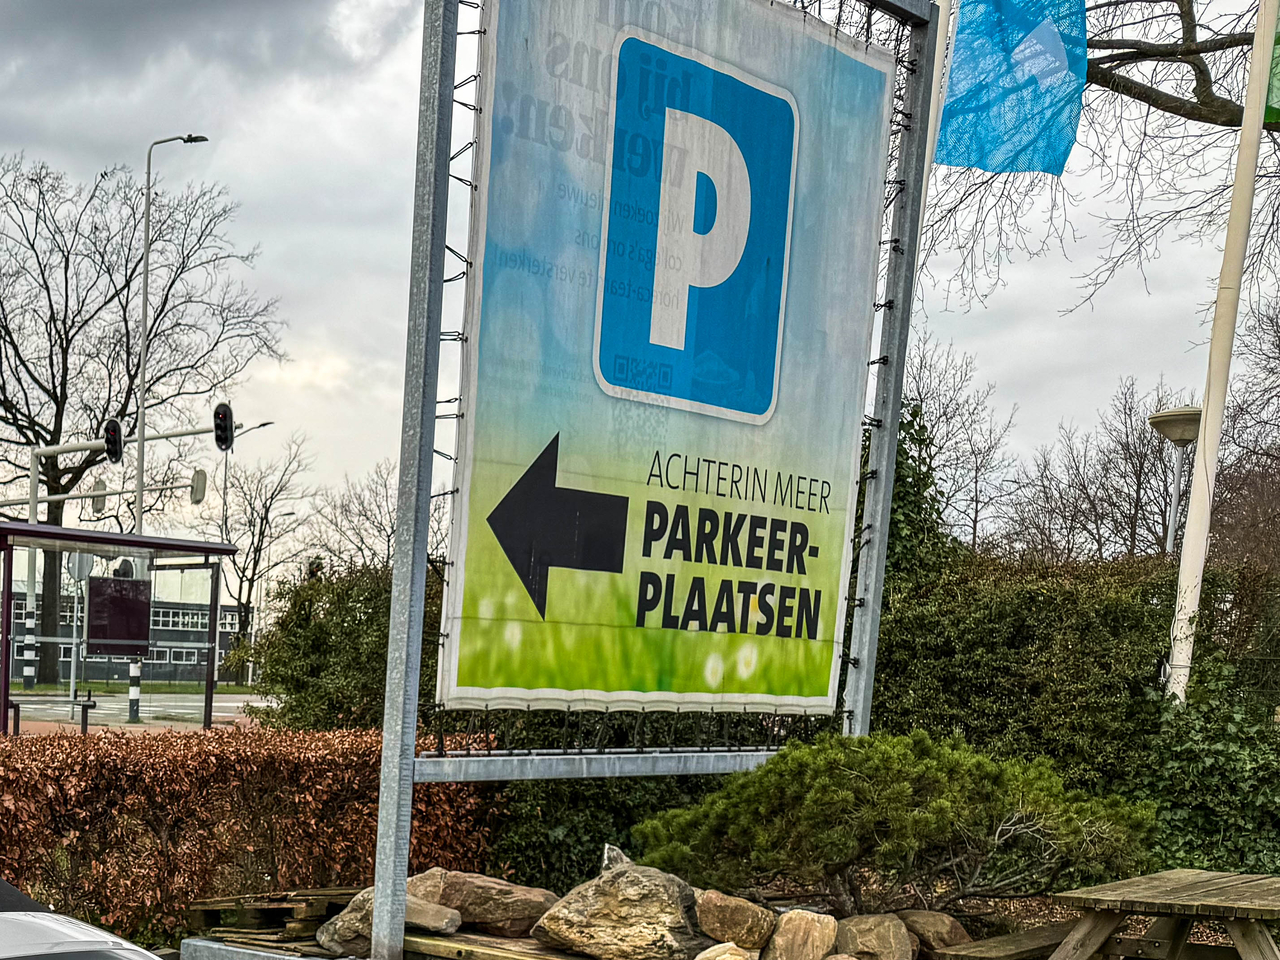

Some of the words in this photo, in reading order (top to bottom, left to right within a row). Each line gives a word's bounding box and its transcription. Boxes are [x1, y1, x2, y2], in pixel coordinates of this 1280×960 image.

[646, 450, 769, 504] ACHTERIN
[773, 471, 832, 515] MEER
[641, 500, 820, 576] PARKEER-
[635, 570, 823, 641] PLAATSEN
